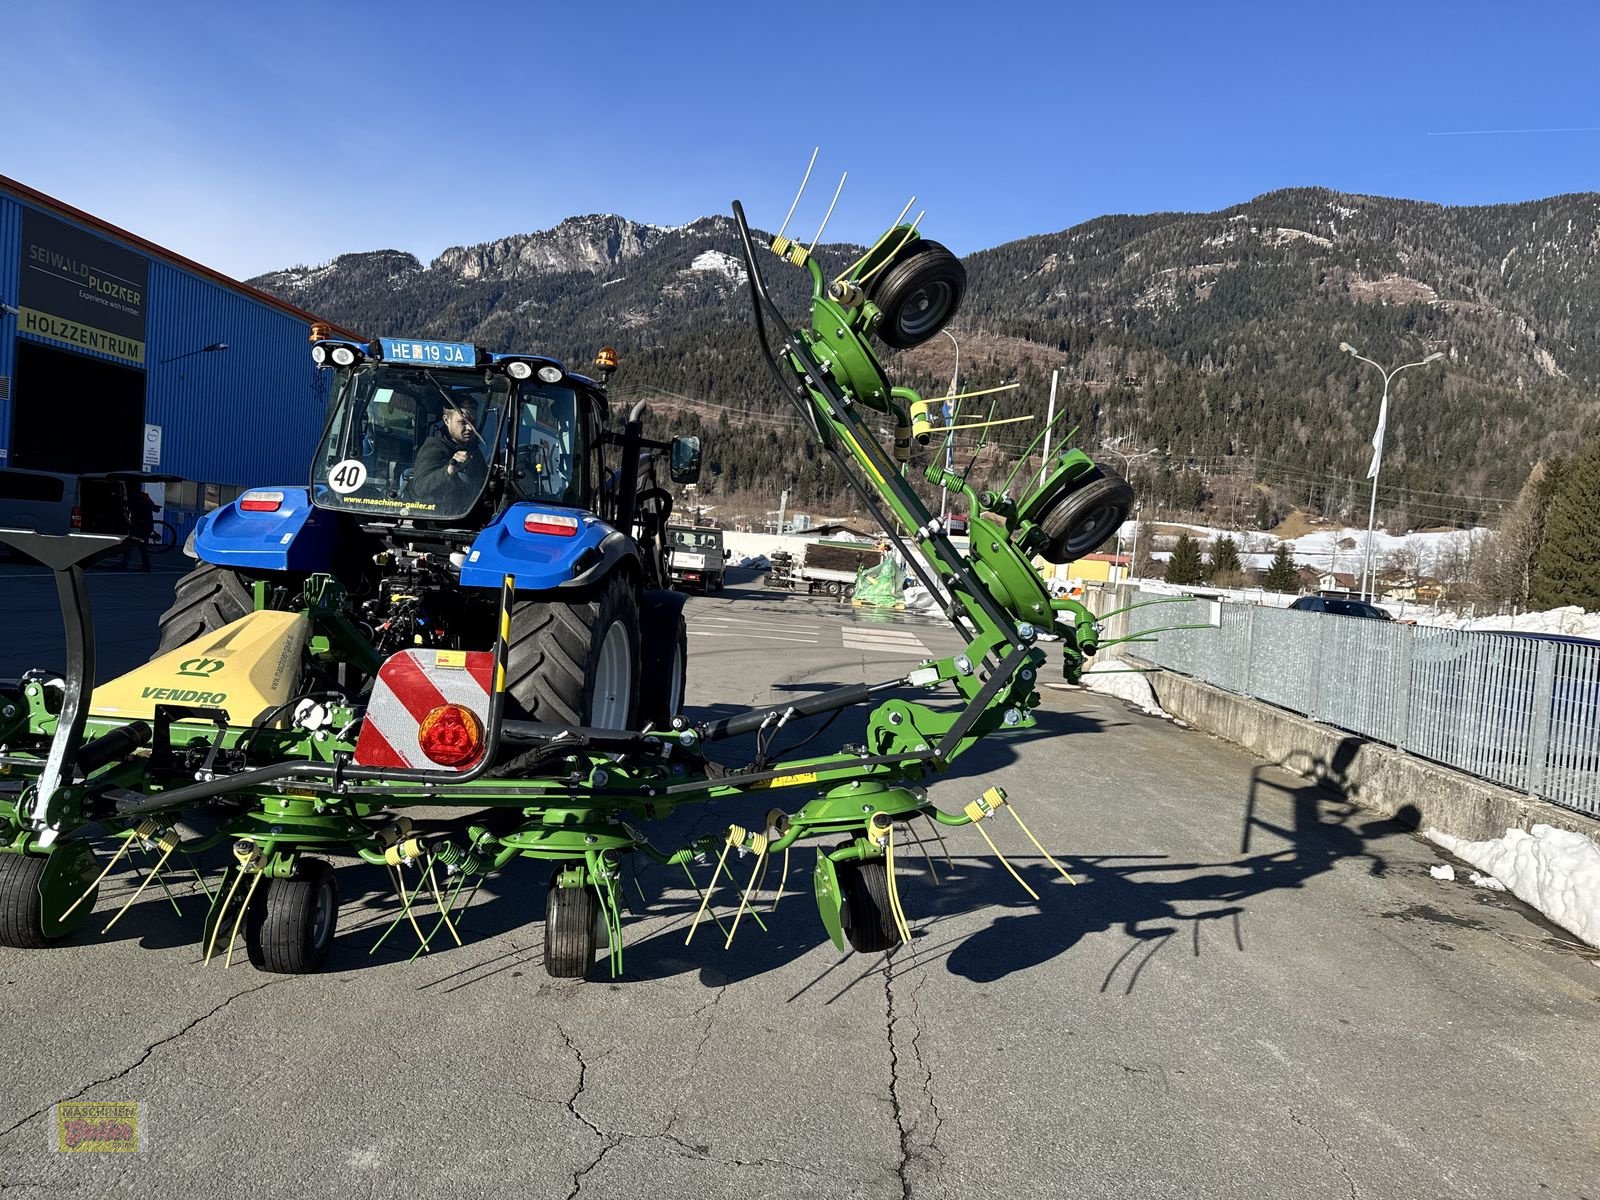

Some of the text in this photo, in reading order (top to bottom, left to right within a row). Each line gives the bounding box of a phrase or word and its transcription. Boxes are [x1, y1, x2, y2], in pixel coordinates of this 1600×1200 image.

[29, 244, 89, 278] SEIWALD
[79, 290, 109, 306] Experience
[109, 302, 122, 310] with
[88, 275, 141, 306] PLOZNER
[26, 312, 139, 359] HOLZZENTRUM
[391, 343, 464, 362] HE 19 JA
[333, 466, 360, 487] 40
[343, 496, 436, 511] www.maschinen-gailer.at
[141, 687, 227, 704] VENDRO
